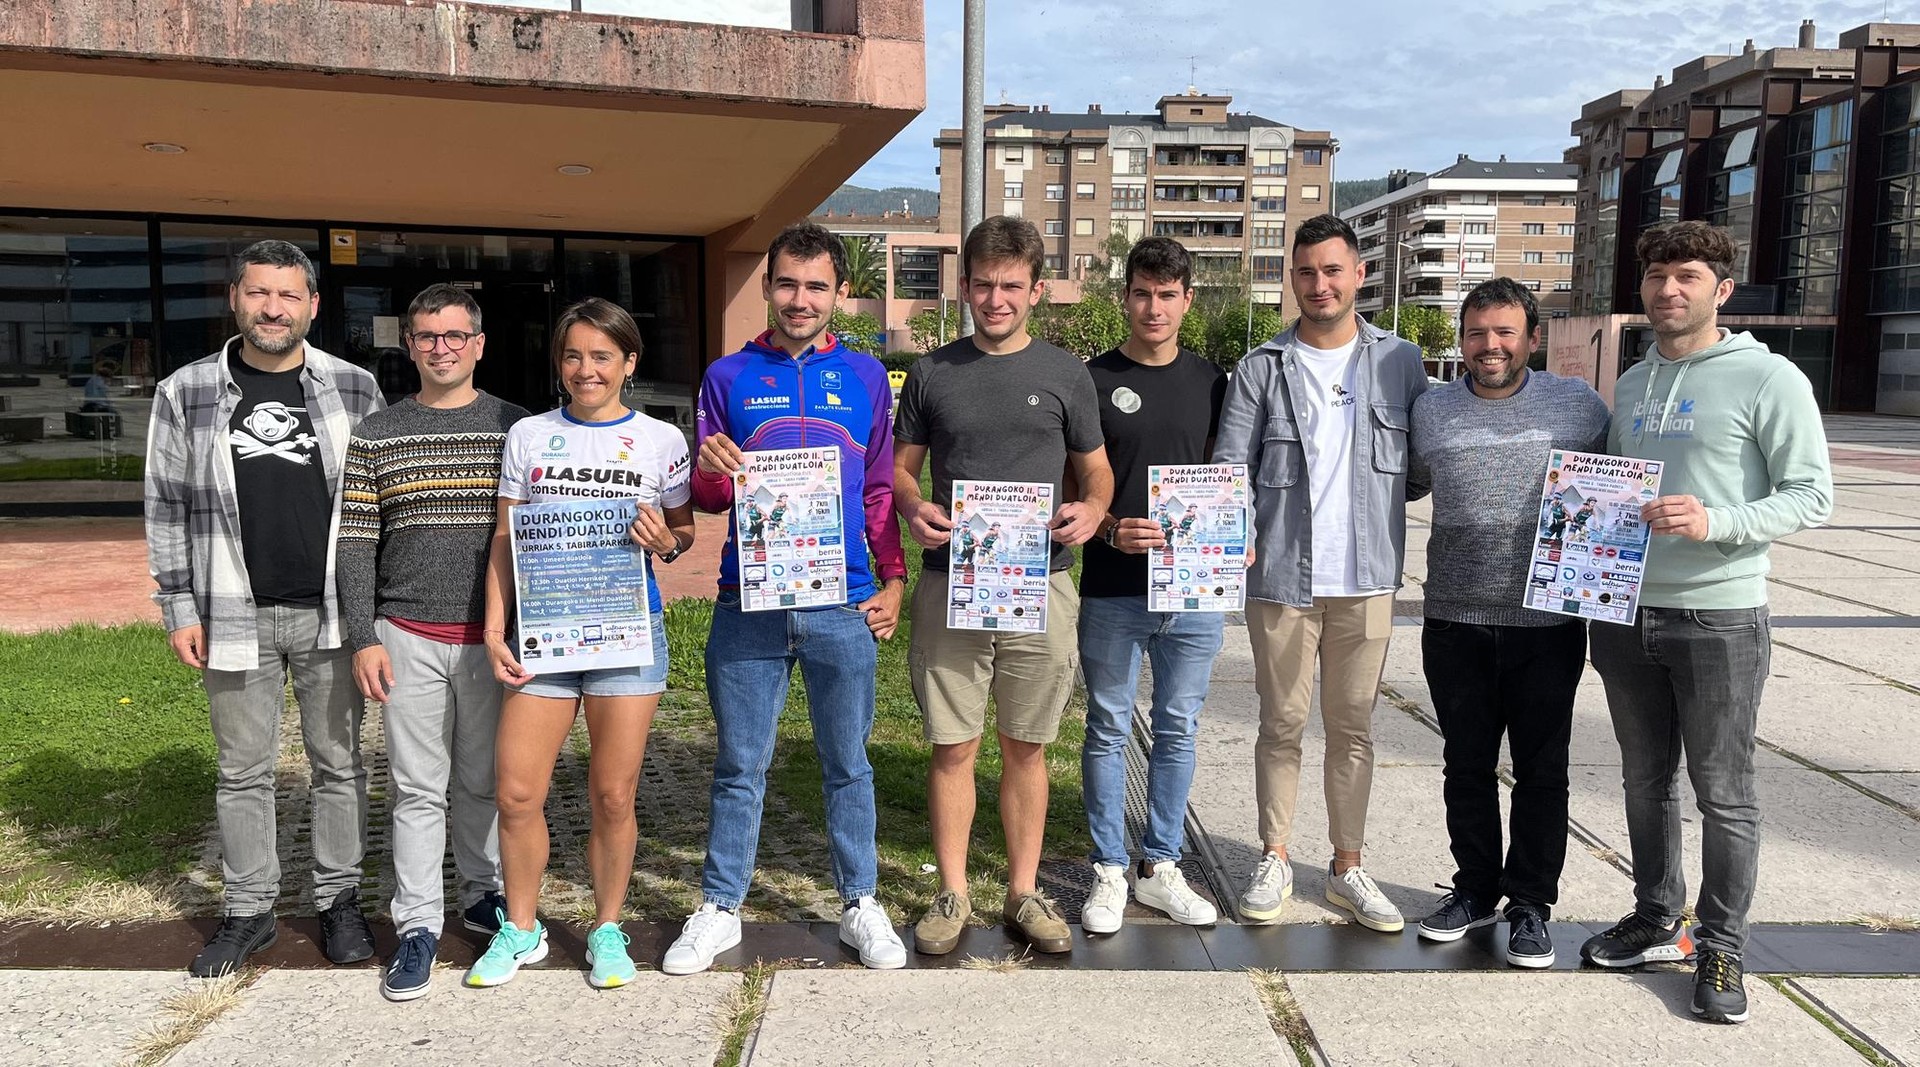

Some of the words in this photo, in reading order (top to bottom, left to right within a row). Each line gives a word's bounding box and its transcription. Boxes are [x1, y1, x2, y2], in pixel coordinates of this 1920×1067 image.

[751, 396, 790, 404] LASUEN
[1331, 396, 1356, 407] PEACE
[744, 403, 790, 411] construcciones
[1645, 414, 1694, 432] iblian
[756, 452, 809, 463] DURANGOKO
[1573, 455, 1630, 468] DURANGOKO
[749, 464, 777, 473] MENDI
[780, 461, 824, 471] DUATLOIA
[1169, 467, 1219, 475] DURANGOKO
[1563, 464, 1593, 473] MENDI
[1596, 467, 1643, 480] DUATLOIA
[545, 466, 643, 488] LASUEN
[1162, 476, 1188, 484] MENDI
[1191, 475, 1232, 483] DUATLOIA
[974, 485, 1024, 494] DURANGOKO
[996, 495, 1037, 503] DUATLOIA
[521, 509, 615, 526] DURANGOKO
[515, 527, 562, 541] MENDI
[567, 522, 630, 537] DUATLOI
[521, 543, 554, 553] URRIAK
[556, 542, 564, 551] 5,
[566, 540, 598, 549] TABIRA
[600, 538, 634, 548] PARKEA
[818, 548, 842, 556] berria
[1223, 557, 1244, 565] berria
[1615, 562, 1641, 573] berria
[1608, 573, 1639, 583] LASUEN
